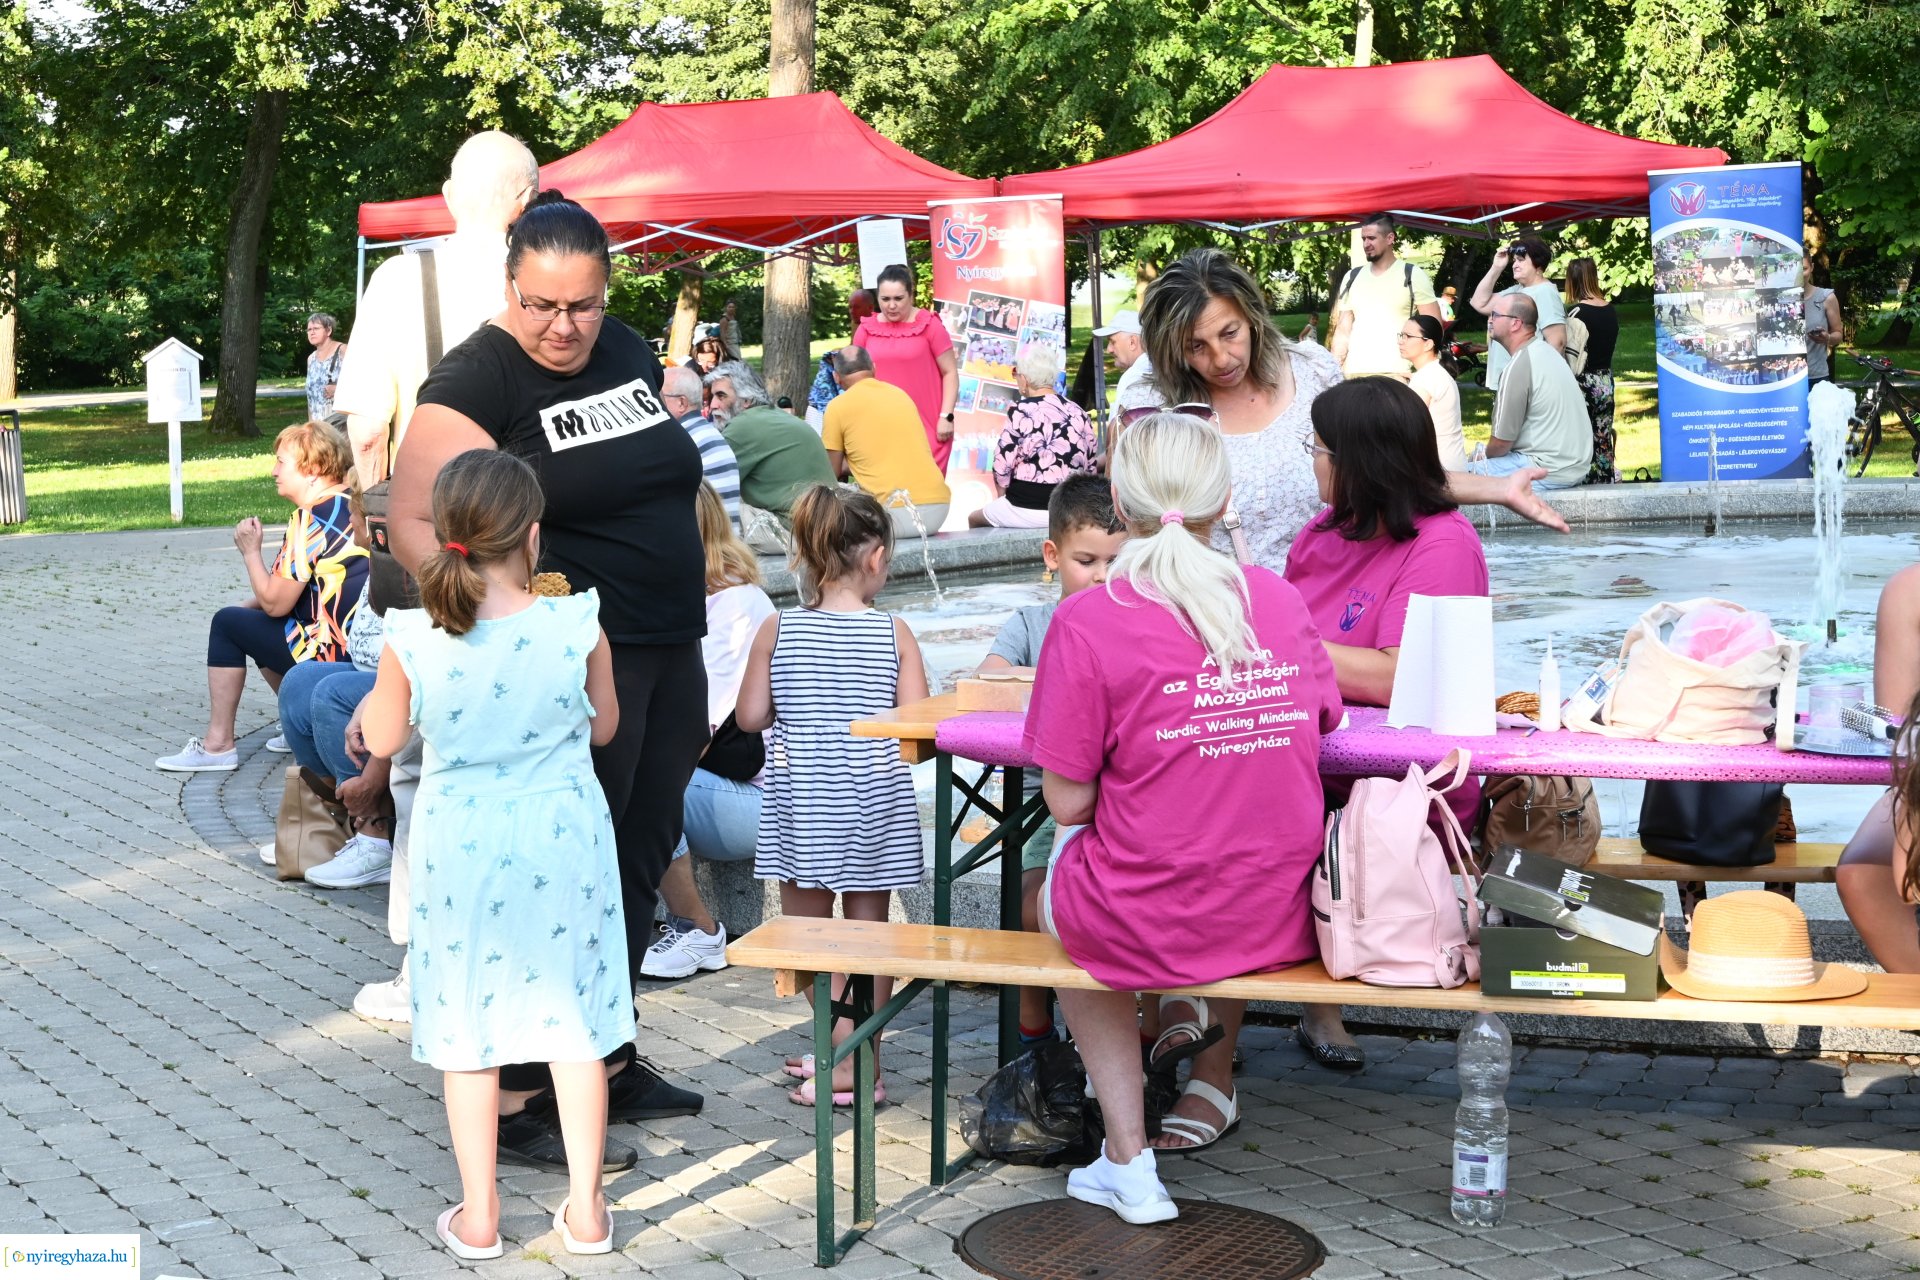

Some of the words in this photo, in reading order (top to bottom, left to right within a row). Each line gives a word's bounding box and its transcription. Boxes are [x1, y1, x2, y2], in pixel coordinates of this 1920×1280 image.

[1717, 181, 1769, 197] TÉMA
[551, 389, 660, 440] MUSTANG
[1162, 680, 1188, 695] az
[1196, 662, 1300, 690] Egszségért
[1193, 681, 1289, 708] Mozgalom!
[1155, 723, 1201, 742] Nordic
[1205, 716, 1254, 733] Walking
[1199, 735, 1291, 759] Nyíregyháza
[1546, 961, 1578, 972] budmil
